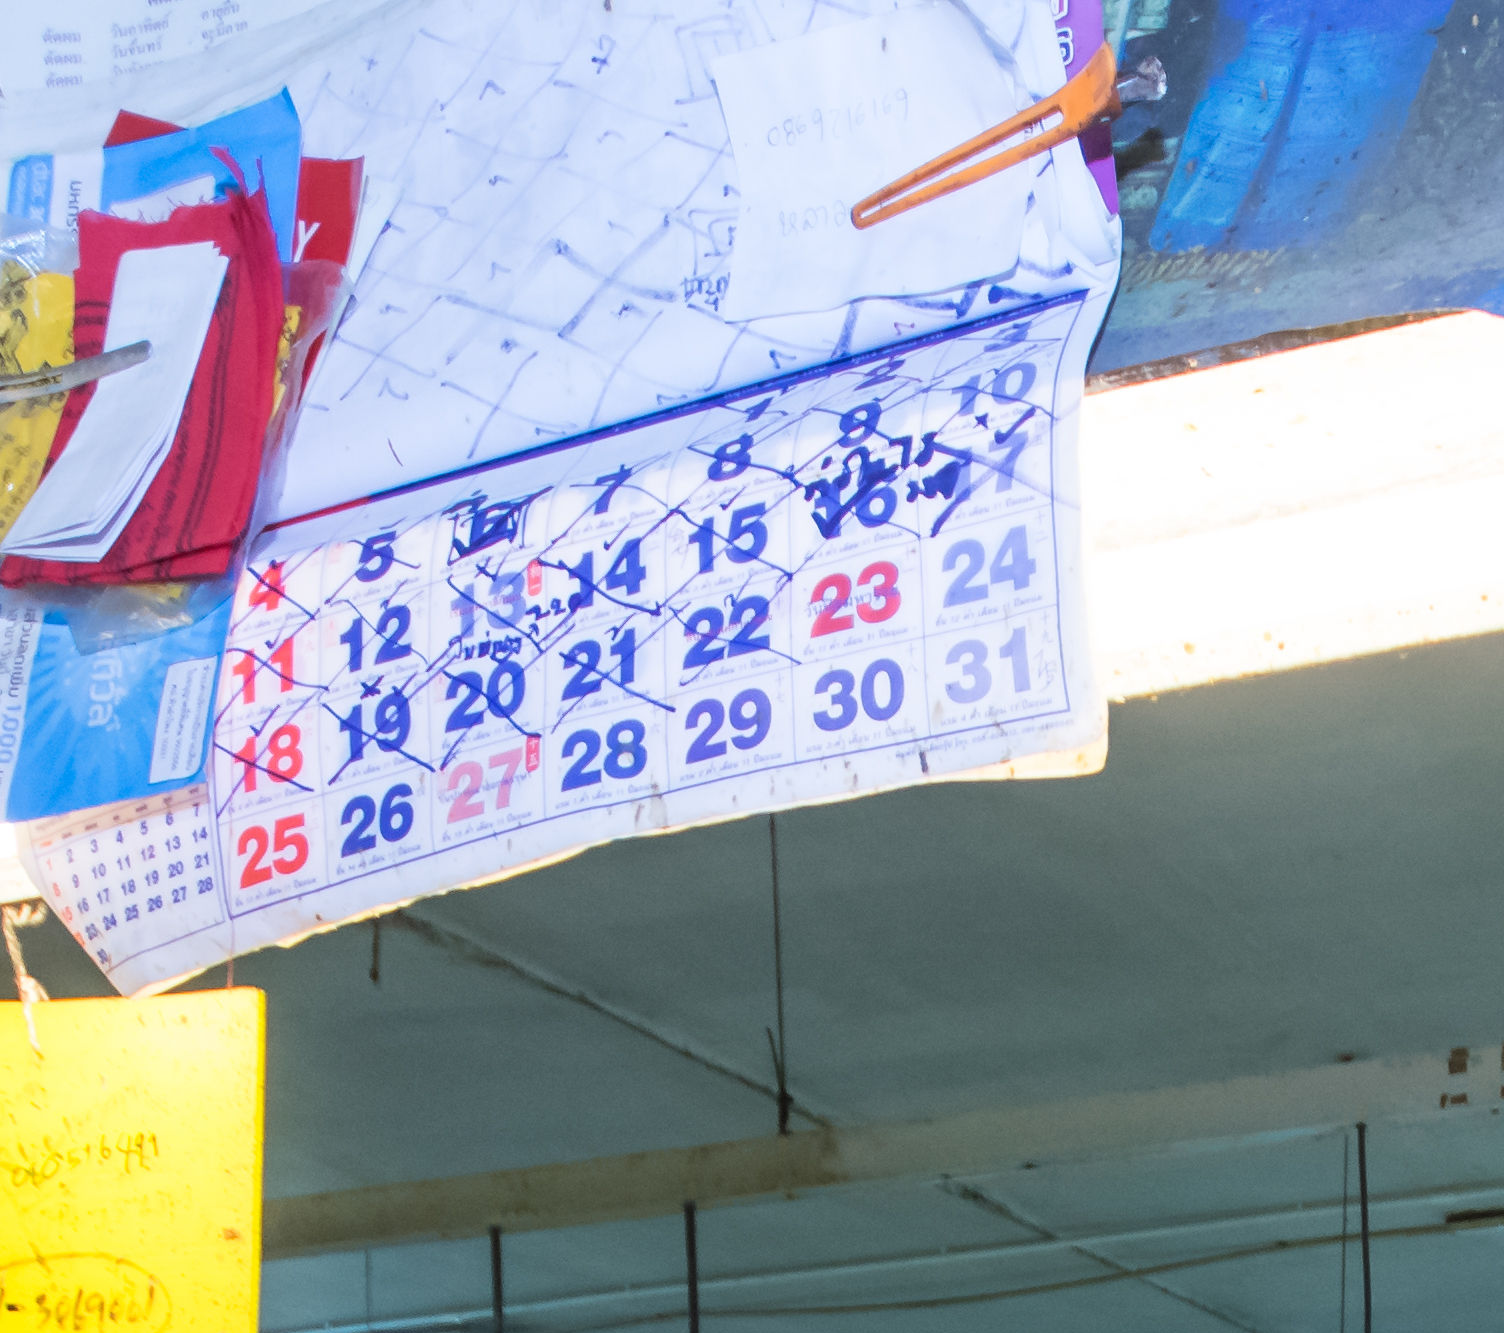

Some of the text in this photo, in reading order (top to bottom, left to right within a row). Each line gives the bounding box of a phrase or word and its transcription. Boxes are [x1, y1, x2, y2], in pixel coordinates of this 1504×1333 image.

[249, 561, 286, 611] 4
[356, 531, 396, 582] 5
[708, 434, 753, 482] 8
[839, 402, 882, 448] 9
[952, 362, 1037, 416] 10
[232, 636, 294, 704] 11
[340, 605, 411, 673] 12
[452, 571, 527, 637] 13
[568, 538, 646, 608] 14
[690, 503, 768, 573] 15
[234, 723, 303, 793] 18
[340, 695, 411, 761] 19
[444, 661, 526, 733] 20
[561, 628, 636, 701] 21
[683, 594, 770, 670] 22
[810, 561, 901, 638] 23
[942, 525, 1036, 608] 24
[237, 813, 309, 889] 25
[341, 783, 414, 857] 26
[447, 747, 523, 824] 27
[561, 719, 648, 792] 28
[685, 688, 771, 764] 29
[813, 659, 905, 731] 30
[945, 627, 1031, 704] 31
[71, 874, 80, 888] 9
[92, 863, 106, 878] 10
[116, 855, 131, 871] 11
[141, 846, 156, 861] 12
[165, 835, 181, 852] 13
[192, 827, 207, 842] 14
[90, 839, 98, 853] 3
[115, 830, 124, 844] 4
[139, 820, 149, 835] 5
[165, 812, 174, 826] 6
[193, 803, 199, 816] 7
[97, 888, 111, 903] 17
[121, 880, 136, 895] 18
[145, 870, 159, 886] 19
[168, 861, 183, 877] 20
[194, 853, 210, 869] 21
[102, 916, 117, 931] 24
[124, 906, 139, 921] 25
[147, 896, 163, 911] 26
[172, 886, 187, 902] 27
[197, 877, 214, 892] 28
